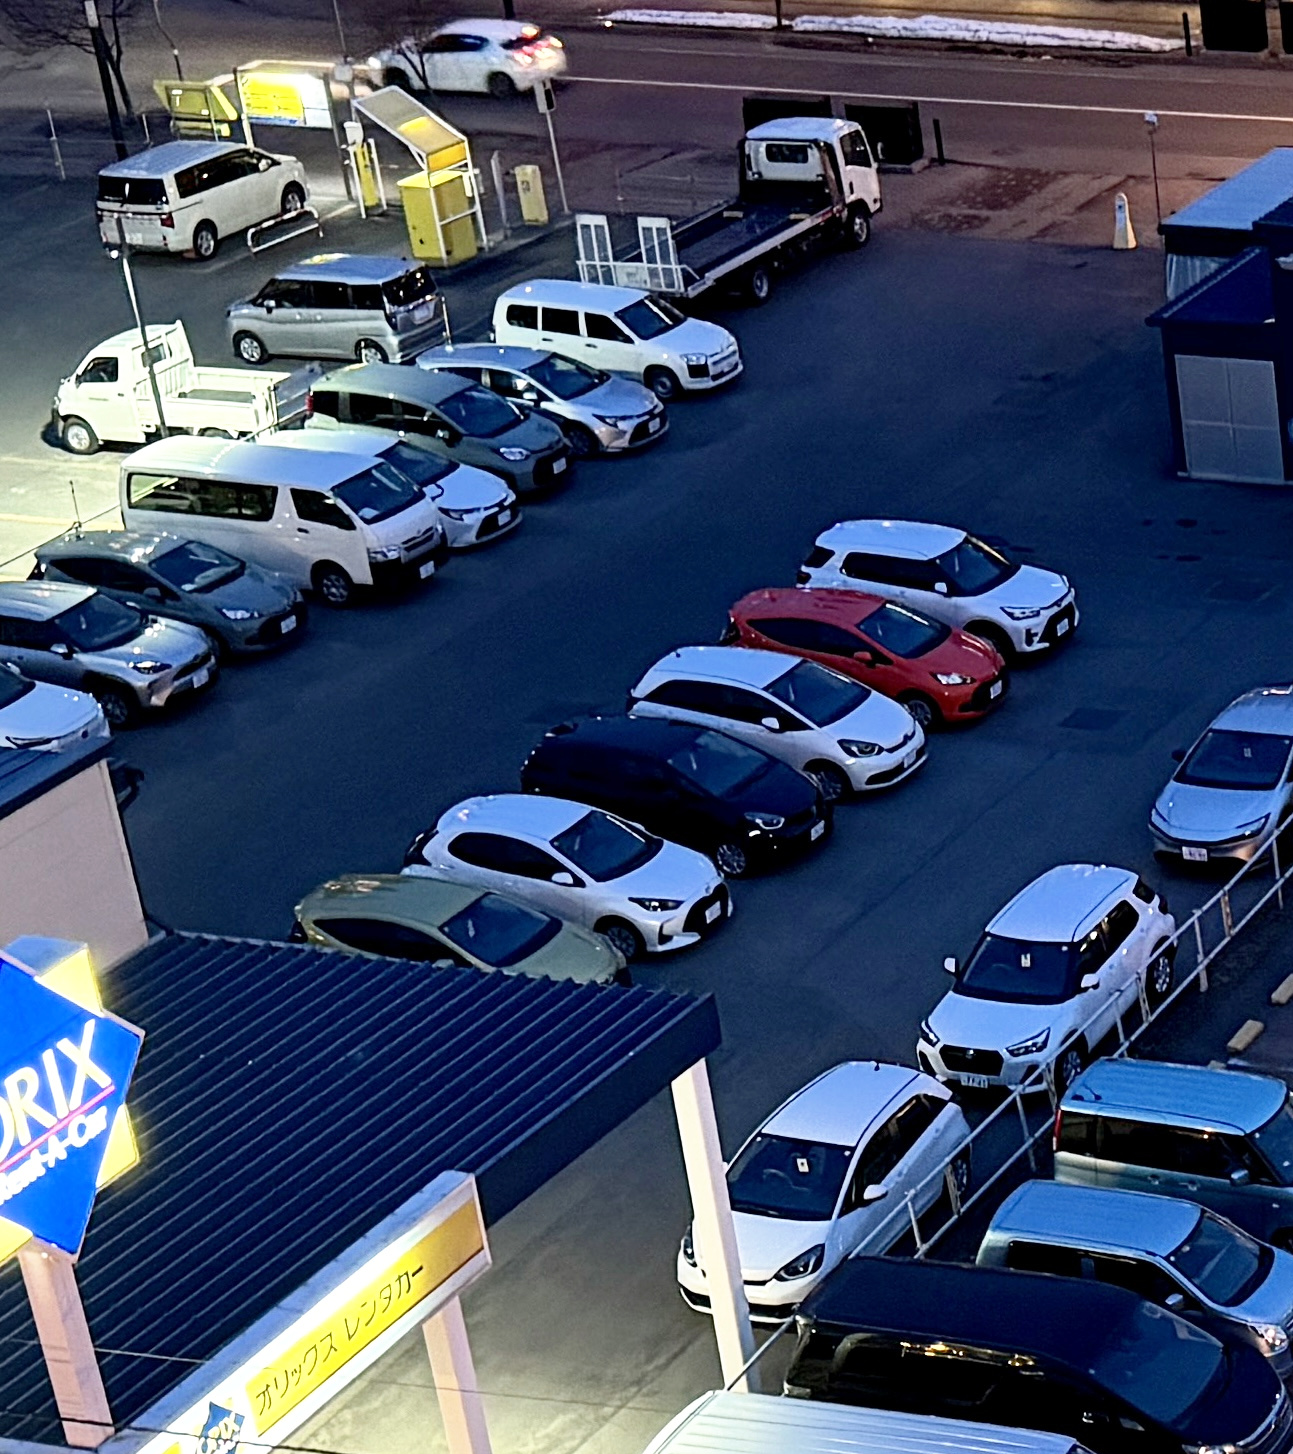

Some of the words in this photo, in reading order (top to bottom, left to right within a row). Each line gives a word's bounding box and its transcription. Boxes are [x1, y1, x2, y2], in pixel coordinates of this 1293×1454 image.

[256, 1332, 338, 1417] オリックス
[344, 1265, 424, 1341] レンタカー
